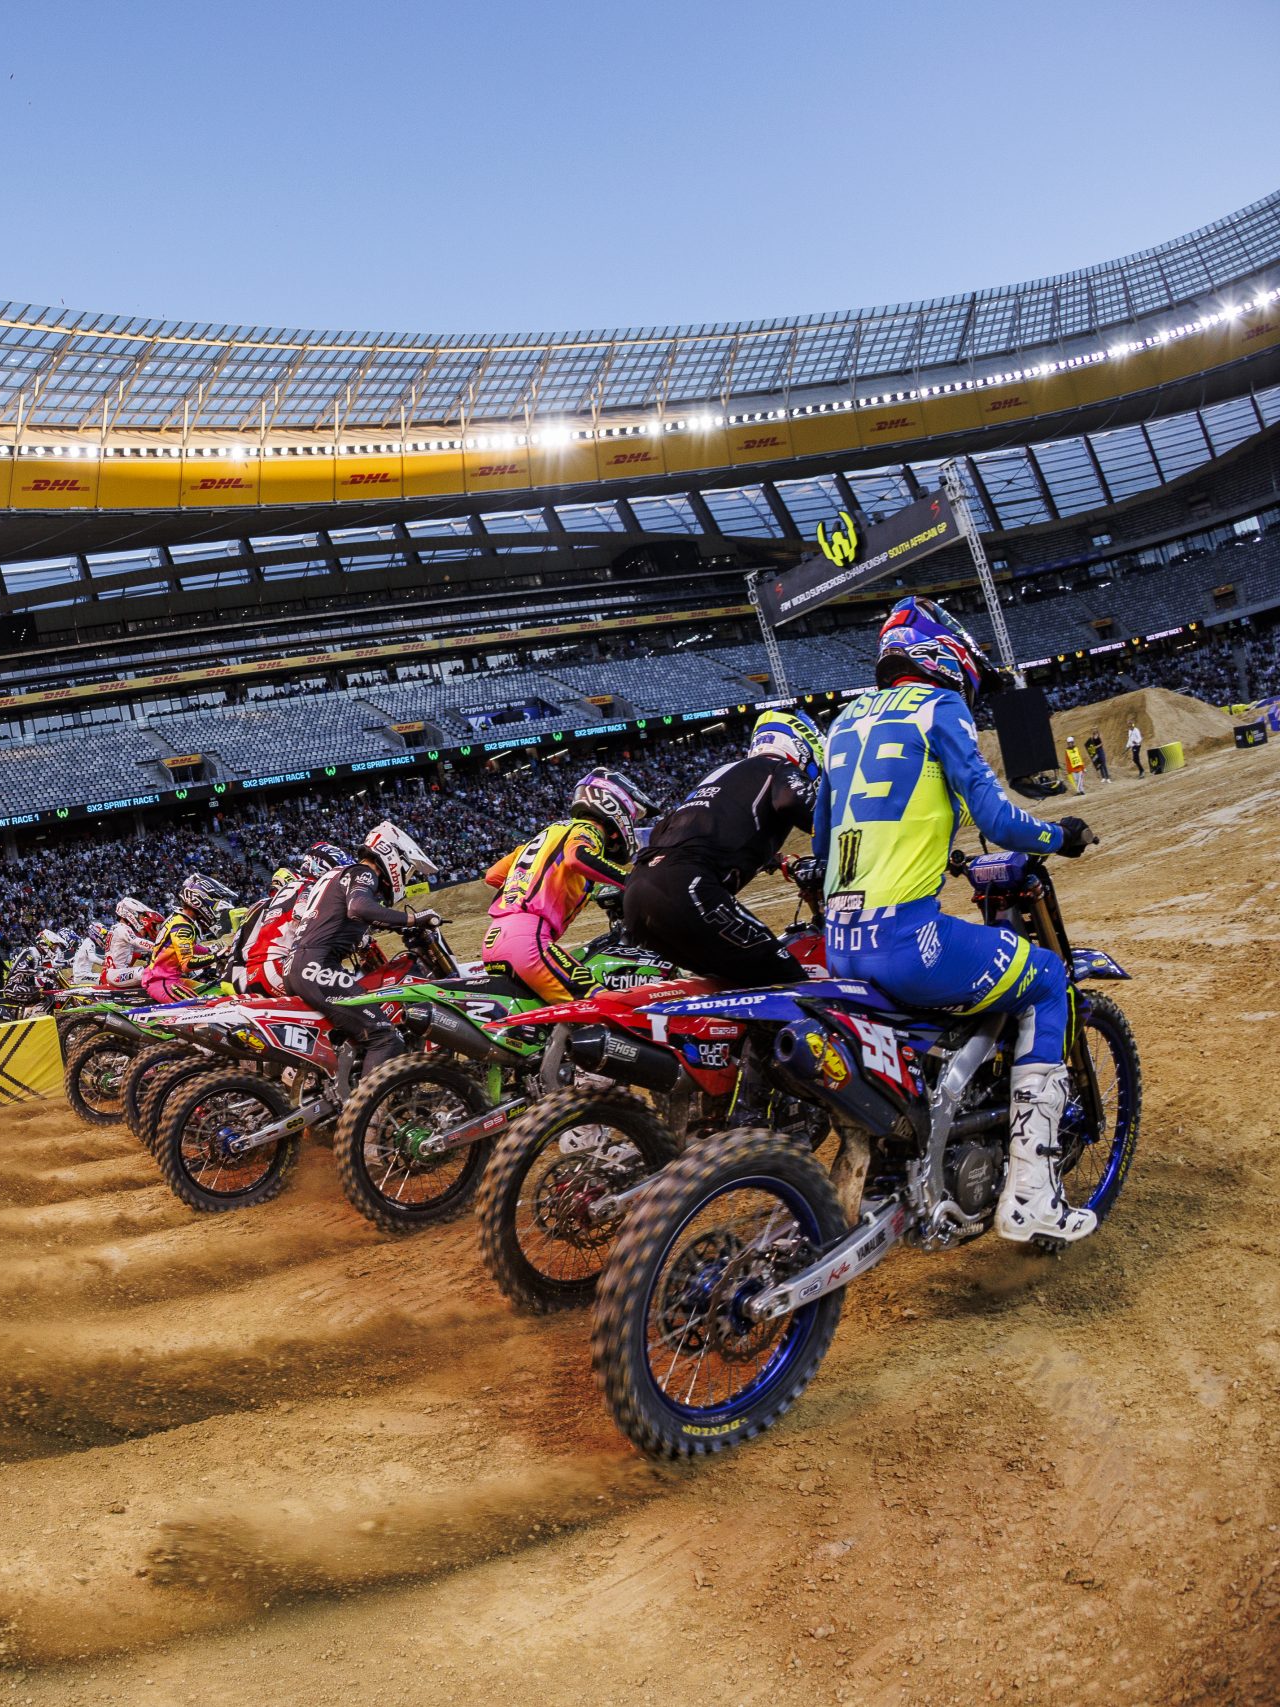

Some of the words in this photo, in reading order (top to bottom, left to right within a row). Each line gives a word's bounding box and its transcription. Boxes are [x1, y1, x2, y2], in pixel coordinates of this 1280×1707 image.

[876, 417, 910, 431] DHL
[742, 436, 782, 450] DHL
[612, 451, 652, 464] DHL
[478, 464, 520, 476] DHL
[199, 478, 244, 490] DHL
[348, 472, 391, 485] DHL
[32, 479, 82, 491] DHL
[810, 574, 846, 597] SUPERCROSS
[846, 552, 888, 581] CHAMPIONSHIP
[888, 542, 910, 559] SOUTH
[938, 522, 948, 534] GP
[540, 626, 562, 634] DHL
[579, 622, 601, 630] DHL
[454, 636, 478, 645] DHL
[497, 631, 521, 640] DHL
[355, 648, 380, 658] DHL
[402, 642, 426, 652] DHL
[307, 654, 333, 664] DHL
[256, 661, 283, 670] DHL
[206, 667, 232, 677] DHL
[152, 674, 180, 685] DHL
[98, 682, 128, 692] DHL
[44, 690, 72, 700] DHL
[460, 705, 484, 714] Crypto
[485, 703, 496, 712] for
[496, 700, 526, 710] Eveyone
[574, 729, 586, 737] SX2
[587, 726, 606, 736] SPRINT
[608, 724, 622, 733] RACE
[484, 743, 498, 752] SX2
[498, 740, 520, 749] SPRINT
[520, 738, 537, 746] RACE
[352, 763, 366, 772] SX2
[366, 760, 390, 770] SPRINT
[391, 757, 410, 766] RACE
[242, 778, 258, 788] SX2
[258, 774, 285, 786] SPRINT
[286, 772, 306, 783] RACE
[87, 802, 103, 813] SX2
[104, 798, 132, 811] SPRINT
[132, 796, 154, 806] RACE
[11, 814, 33, 826] RACE
[549, 942, 572, 968] racing
[636, 958, 674, 970] BUD
[302, 961, 354, 988] aero
[648, 989, 686, 1000] HONDA
[836, 984, 868, 996] YAMAHA
[686, 995, 767, 1010] DUNLOP
[182, 1012, 216, 1020] DUNLOP
[440, 1015, 458, 1028] HGS
[646, 1013, 668, 1042] 1
[282, 1024, 308, 1053] 16
[615, 1044, 638, 1058] HGS
[682, 1418, 740, 1436] DUNLOP
